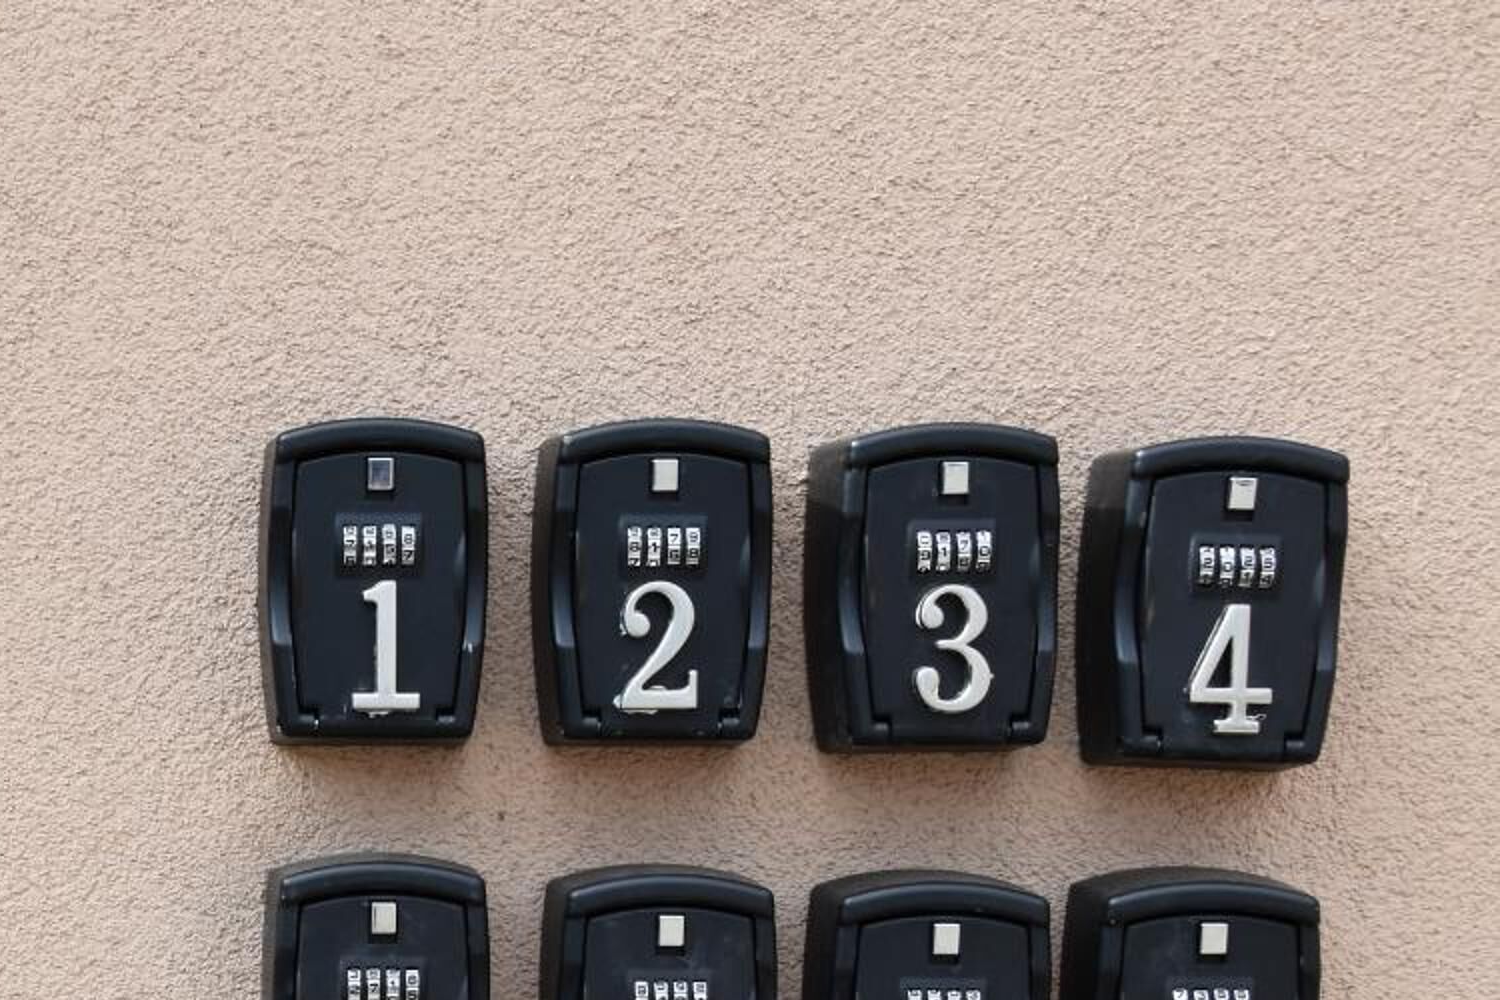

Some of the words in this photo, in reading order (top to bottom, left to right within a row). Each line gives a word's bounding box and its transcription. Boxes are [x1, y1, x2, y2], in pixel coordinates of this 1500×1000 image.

[352, 580, 420, 709] 1
[614, 581, 698, 710] 2
[915, 584, 994, 713] 3
[1189, 603, 1273, 734] 4
